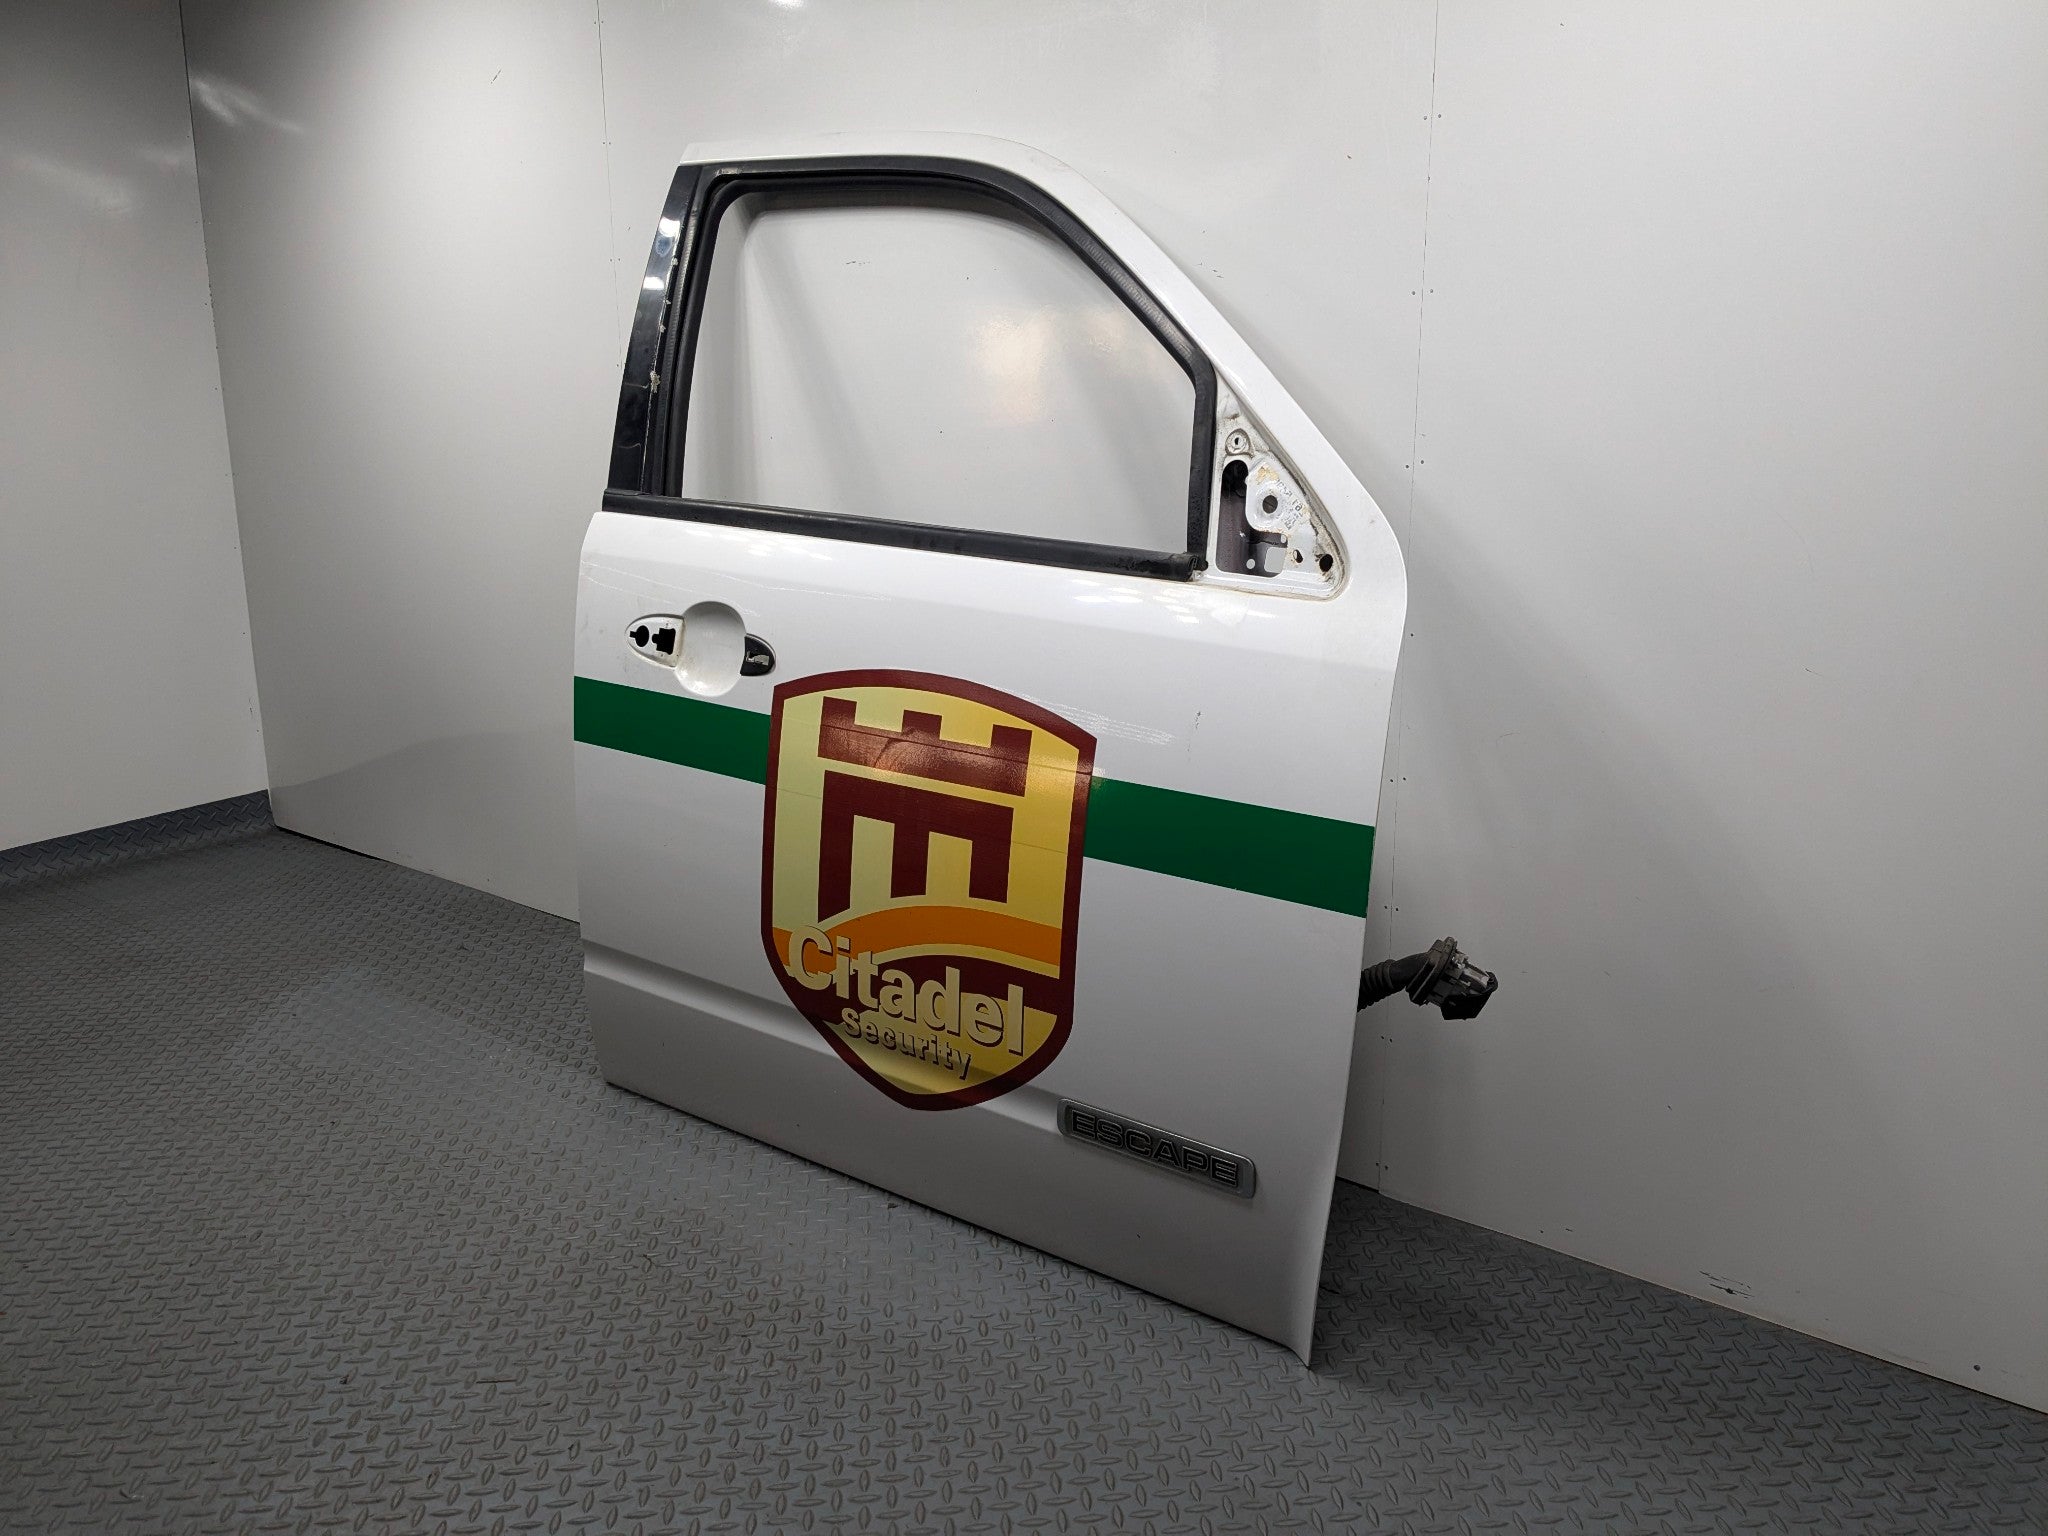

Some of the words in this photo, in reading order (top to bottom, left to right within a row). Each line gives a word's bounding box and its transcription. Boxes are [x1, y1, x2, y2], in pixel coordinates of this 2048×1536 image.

[789, 925, 1024, 1056] Citadel
[841, 1007, 973, 1080] Security
[1071, 1109, 1239, 1188] ESCAPE
